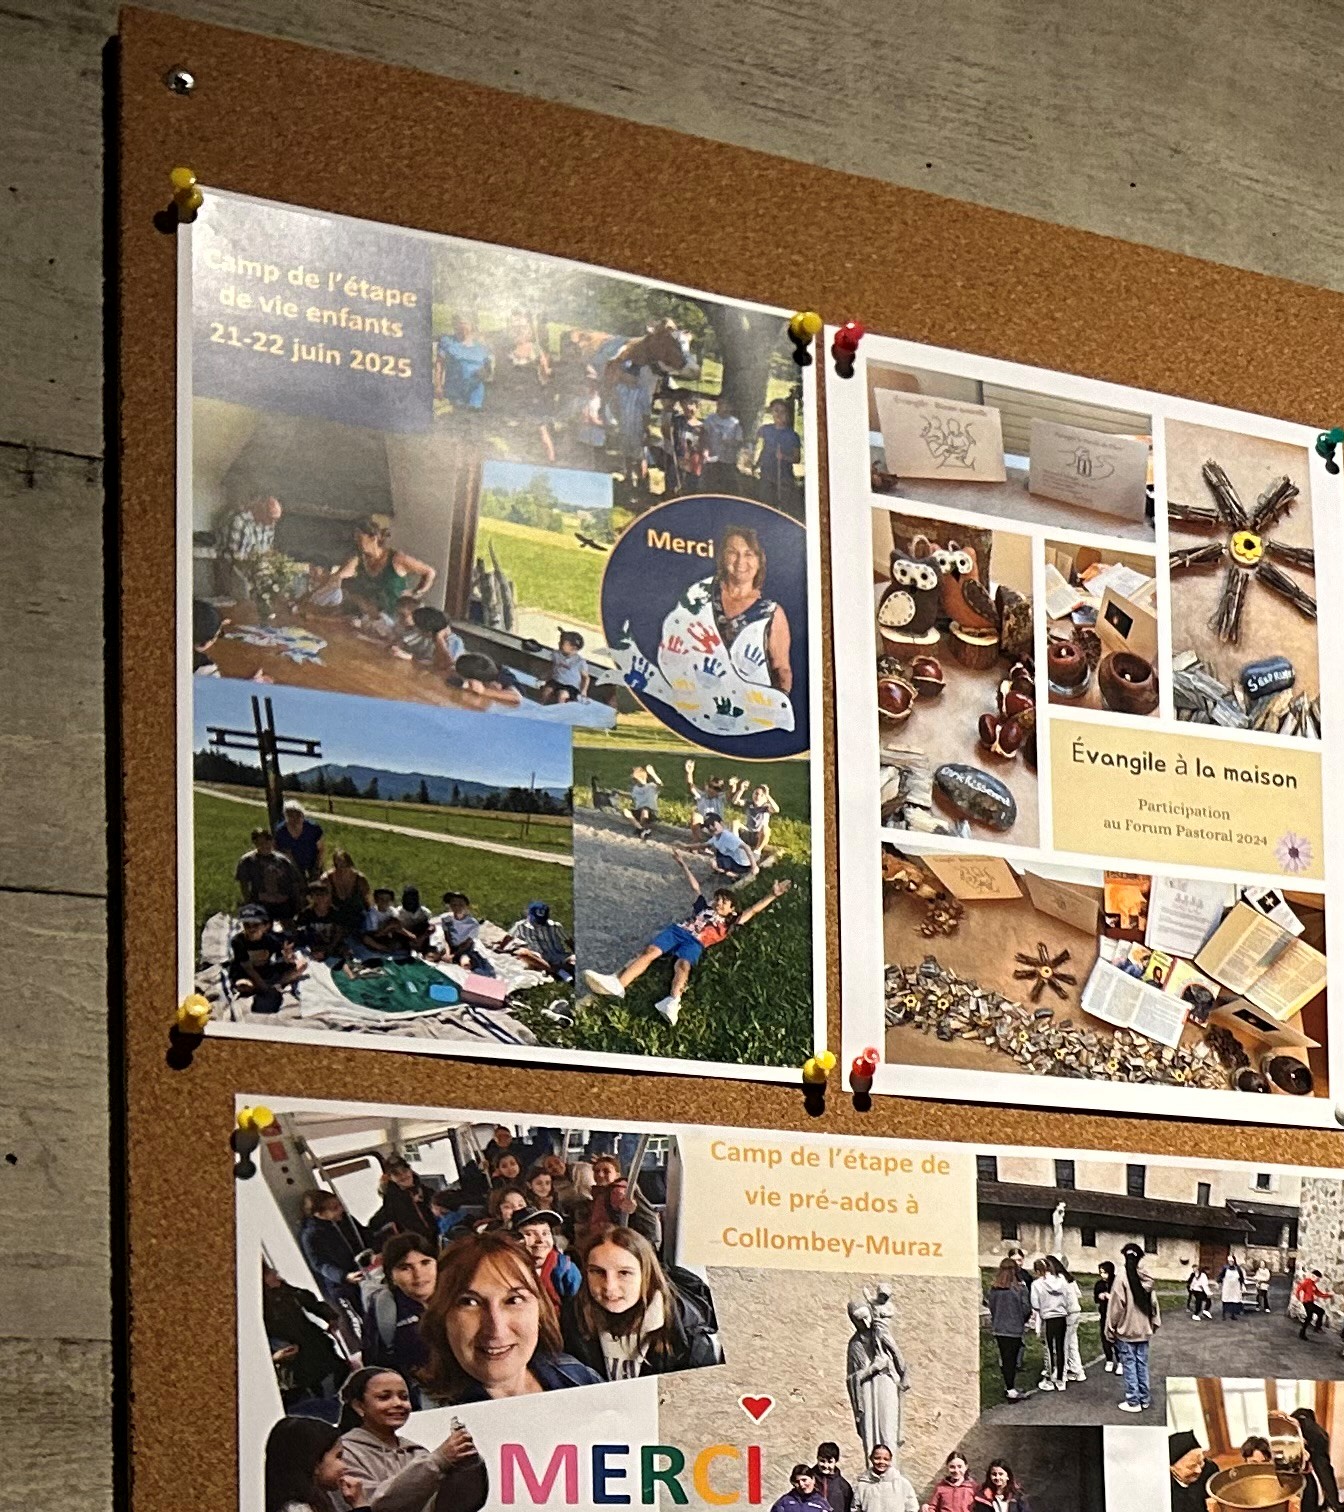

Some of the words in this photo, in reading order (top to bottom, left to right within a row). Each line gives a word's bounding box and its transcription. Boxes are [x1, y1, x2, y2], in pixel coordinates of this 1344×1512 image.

[203, 249, 280, 284] Camp
[287, 265, 321, 289] de
[328, 271, 418, 308] l’étape
[219, 284, 252, 310] de
[258, 294, 299, 319] vie
[305, 305, 405, 338] enfants
[209, 321, 285, 355] 21-22
[290, 337, 342, 366] juin
[349, 349, 413, 379] 2025
[647, 529, 716, 559] Merci
[1071, 735, 1167, 776] Évangile
[1174, 752, 1189, 776] à
[1195, 757, 1217, 780] la
[1223, 764, 1299, 790] maison
[1137, 797, 1232, 821] Participation
[1103, 818, 1122, 831] au
[1125, 818, 1173, 837] Forum
[1175, 824, 1233, 843] Pastoral
[1235, 832, 1269, 847] 2024
[709, 1140, 783, 1169] Camp
[790, 1145, 820, 1168] de
[828, 1147, 914, 1177] l’étape
[921, 1154, 951, 1176] de
[744, 1185, 781, 1207] vie
[789, 1188, 898, 1213] pré-ados
[905, 1193, 919, 1215] à
[721, 1226, 944, 1258] Collombey-Muraz
[499, 1443, 763, 1506] MERCI
